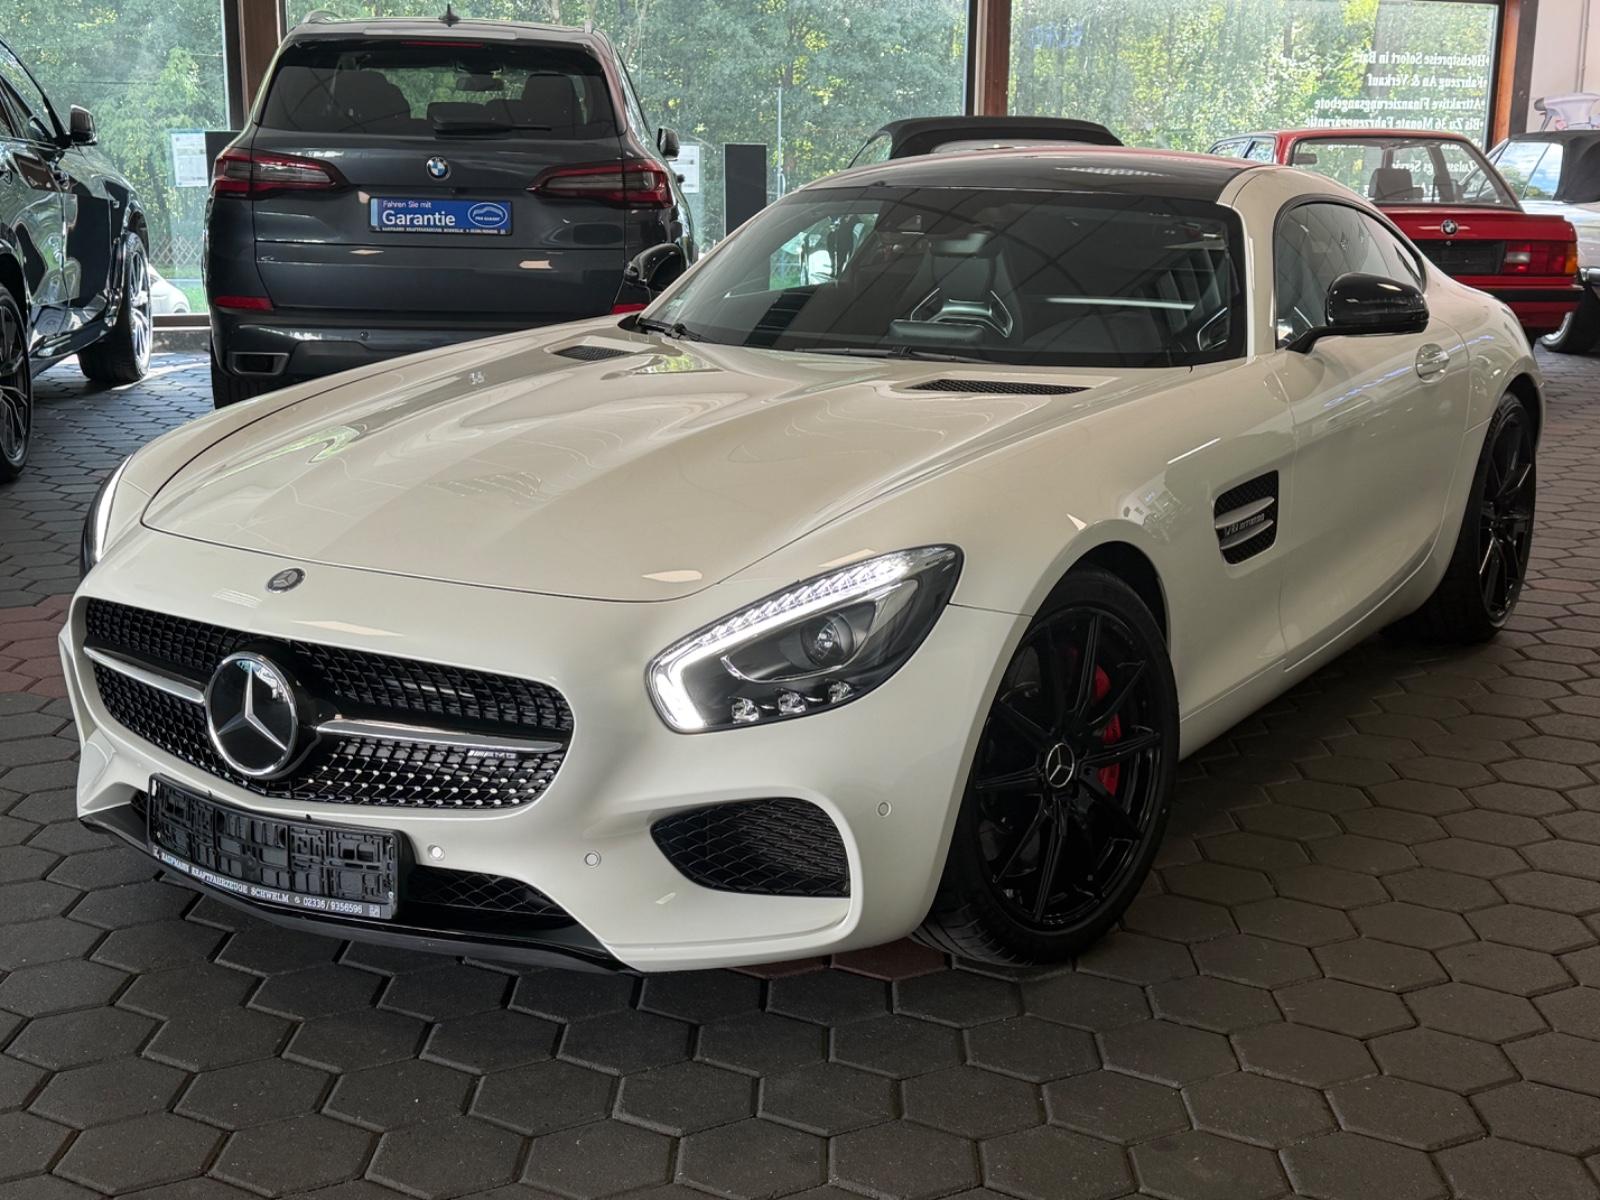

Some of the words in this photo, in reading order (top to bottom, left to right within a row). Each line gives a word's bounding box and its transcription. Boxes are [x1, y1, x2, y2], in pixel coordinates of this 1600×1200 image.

[382, 200, 407, 208] Fahren
[408, 201, 419, 209] Sie
[420, 201, 432, 209] mit
[382, 210, 456, 226] Garantie
[250, 886, 290, 904] SCHWELM
